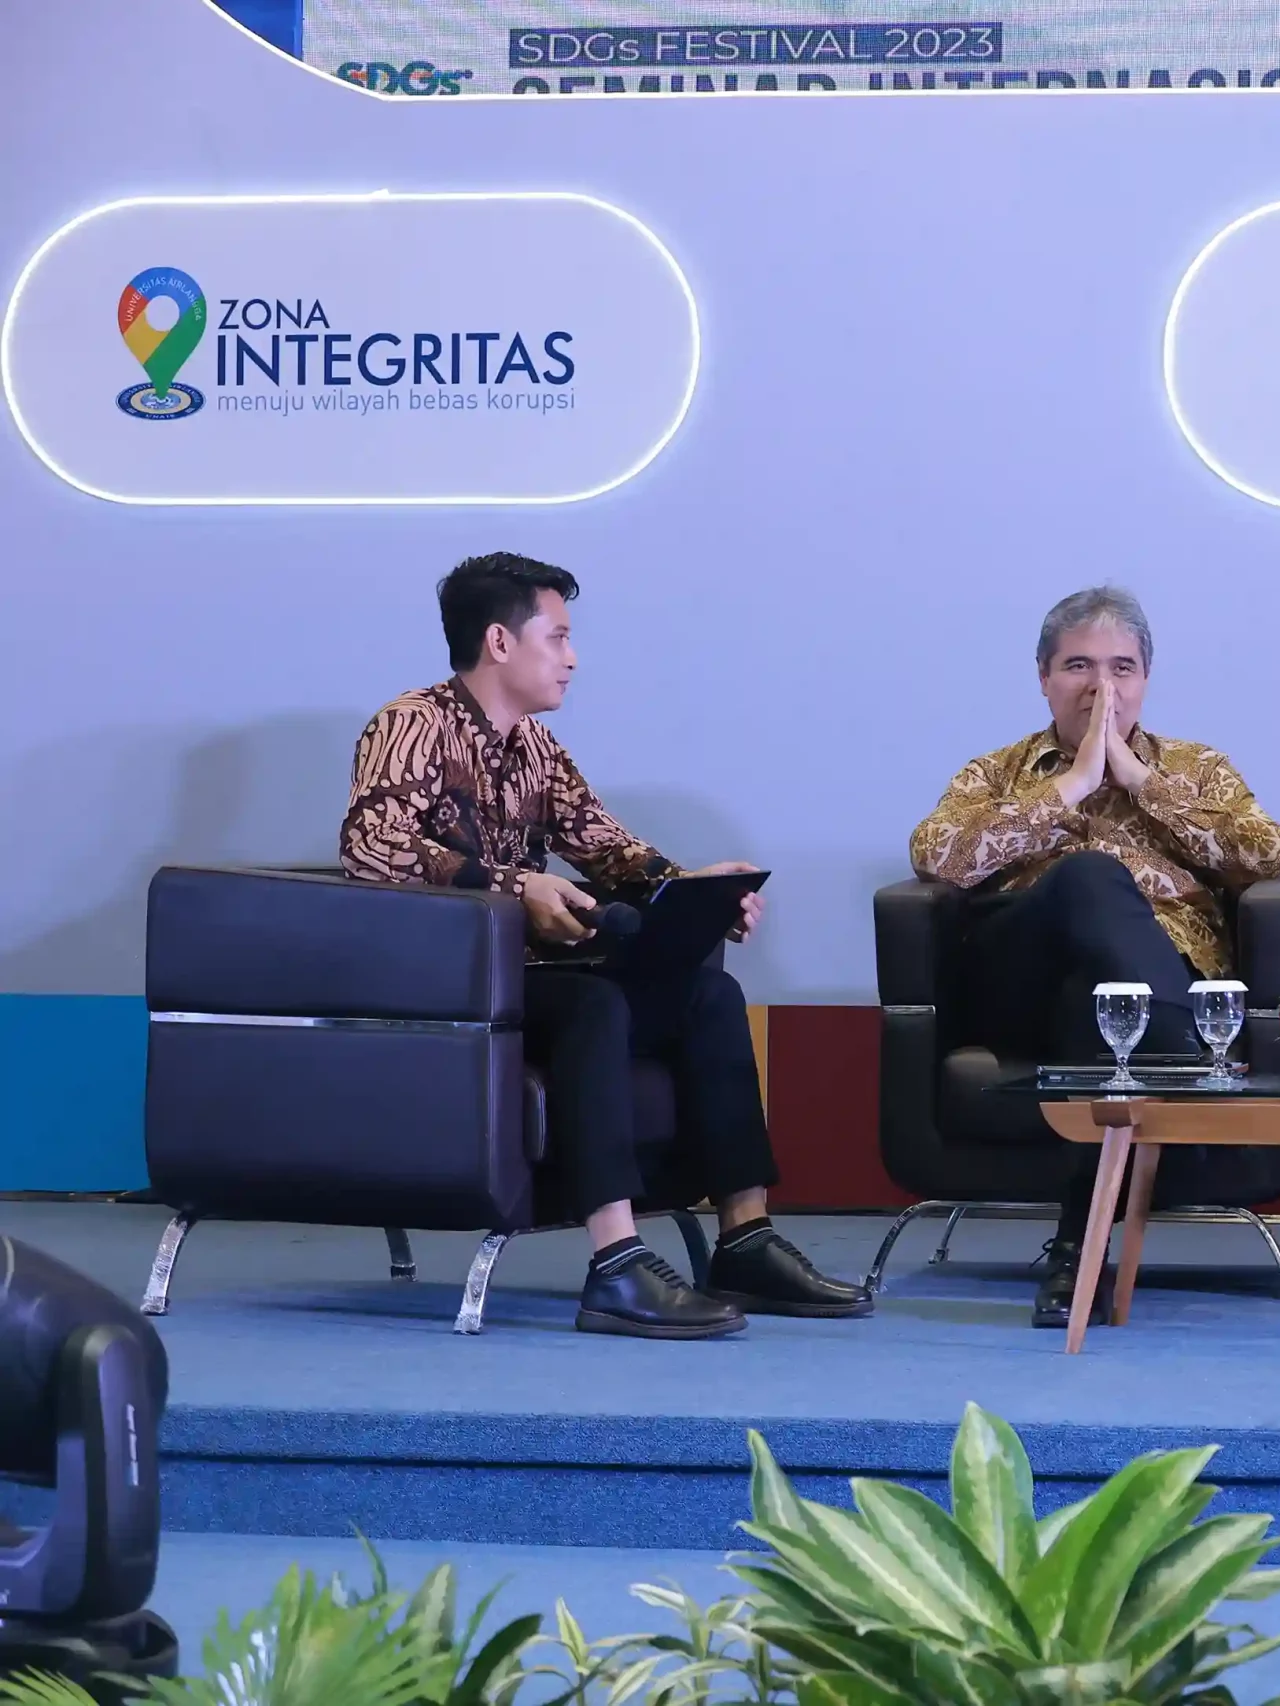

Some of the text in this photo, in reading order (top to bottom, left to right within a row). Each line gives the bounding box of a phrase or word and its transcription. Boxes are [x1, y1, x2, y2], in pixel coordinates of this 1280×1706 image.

[518, 27, 994, 63] SDGs FESTIVAL 2023
[124, 276, 168, 323] UNIVERSITAS
[217, 298, 331, 331] ZONA
[217, 331, 575, 387] INTEGRITAS
[217, 389, 304, 416] menuju
[311, 388, 400, 416] wilayah
[408, 387, 479, 411] bebas
[486, 386, 576, 416] korupsi
